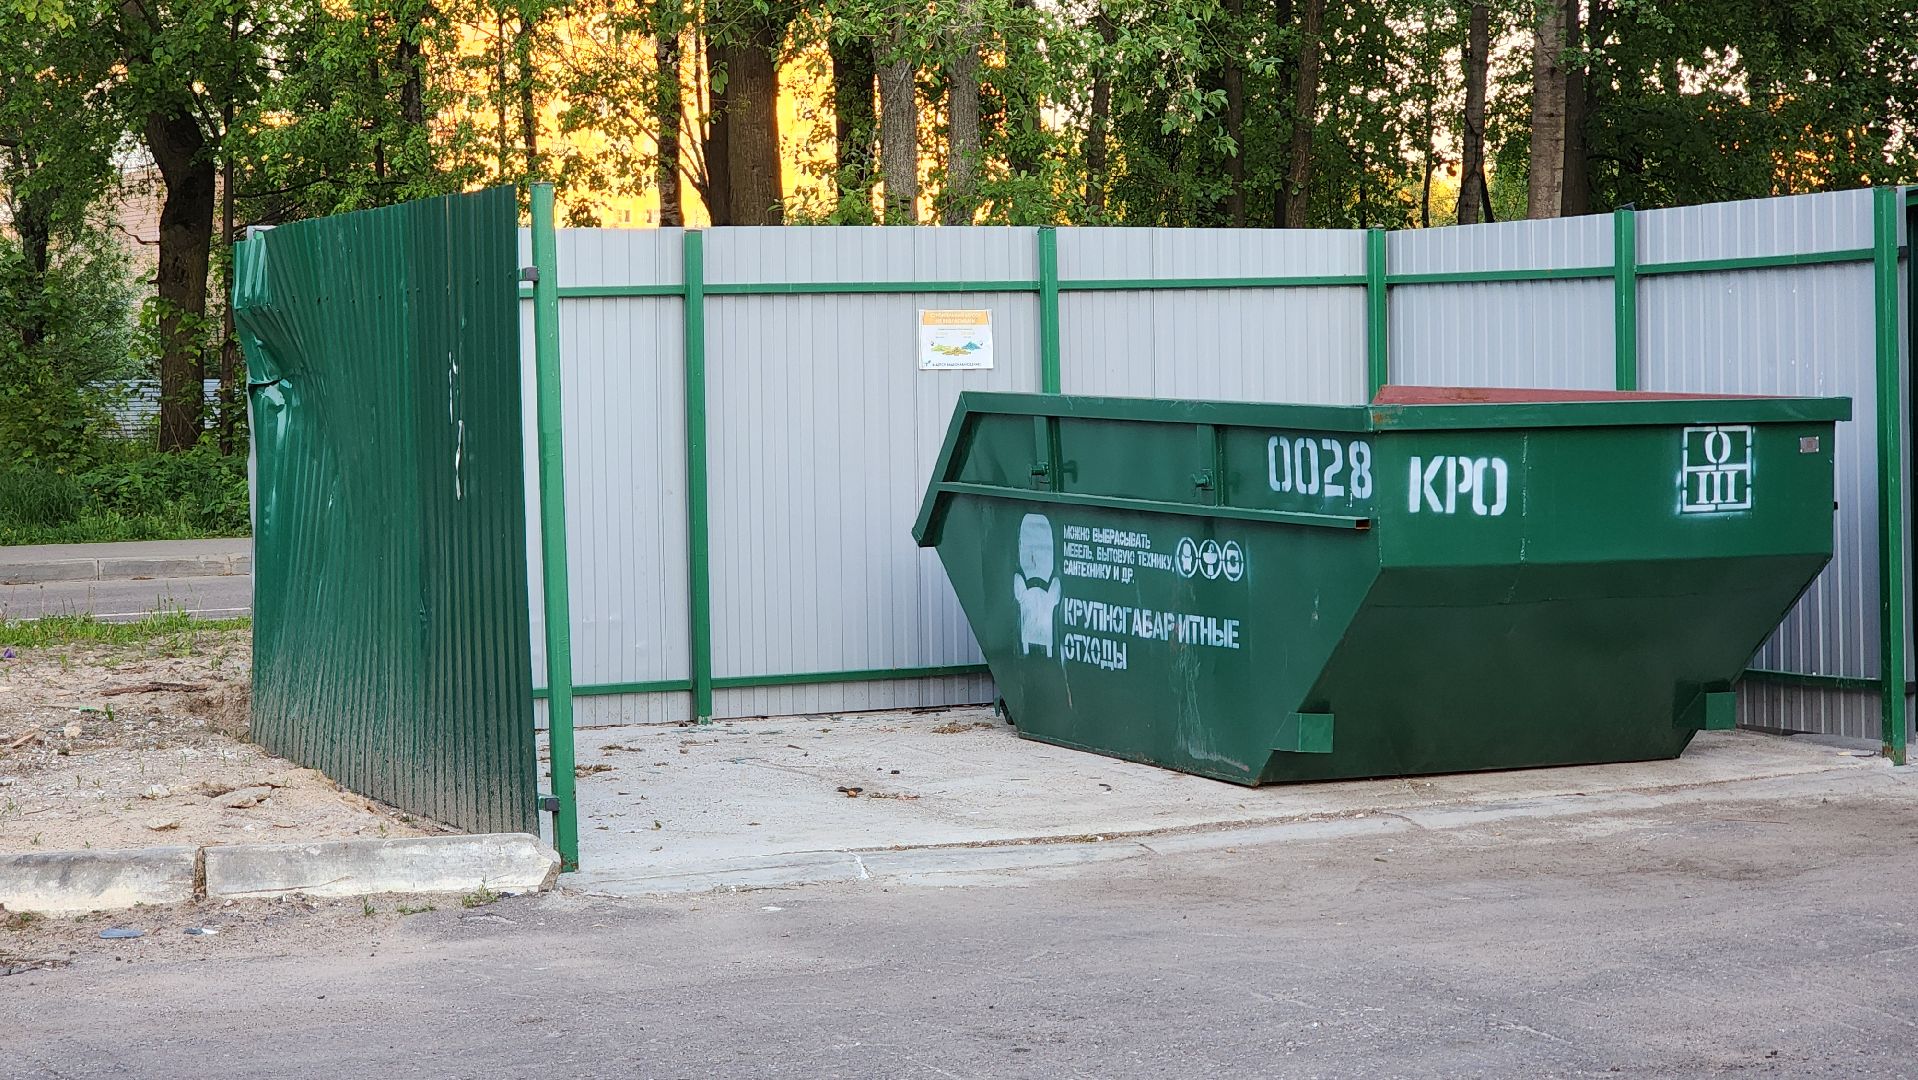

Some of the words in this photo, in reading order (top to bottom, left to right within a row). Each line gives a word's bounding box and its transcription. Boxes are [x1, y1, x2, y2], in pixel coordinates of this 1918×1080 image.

[1268, 436, 1372, 499] 0028
[1409, 456, 1508, 516] КРО
[1063, 524, 1090, 541] МОЖНО
[1092, 528, 1151, 550] ВЫБРАСЫВАТЬ
[1063, 541, 1094, 561] МЕБЕЛЬ,
[1096, 546, 1135, 565] БЫТОВУЮ
[1063, 560, 1112, 580] САНТЕХНИКУ
[1113, 566, 1120, 581] И
[1064, 597, 1240, 649] КРУПНОГАБАРИТНЫЕ
[1064, 633, 1128, 671] ОТХОДЫ
